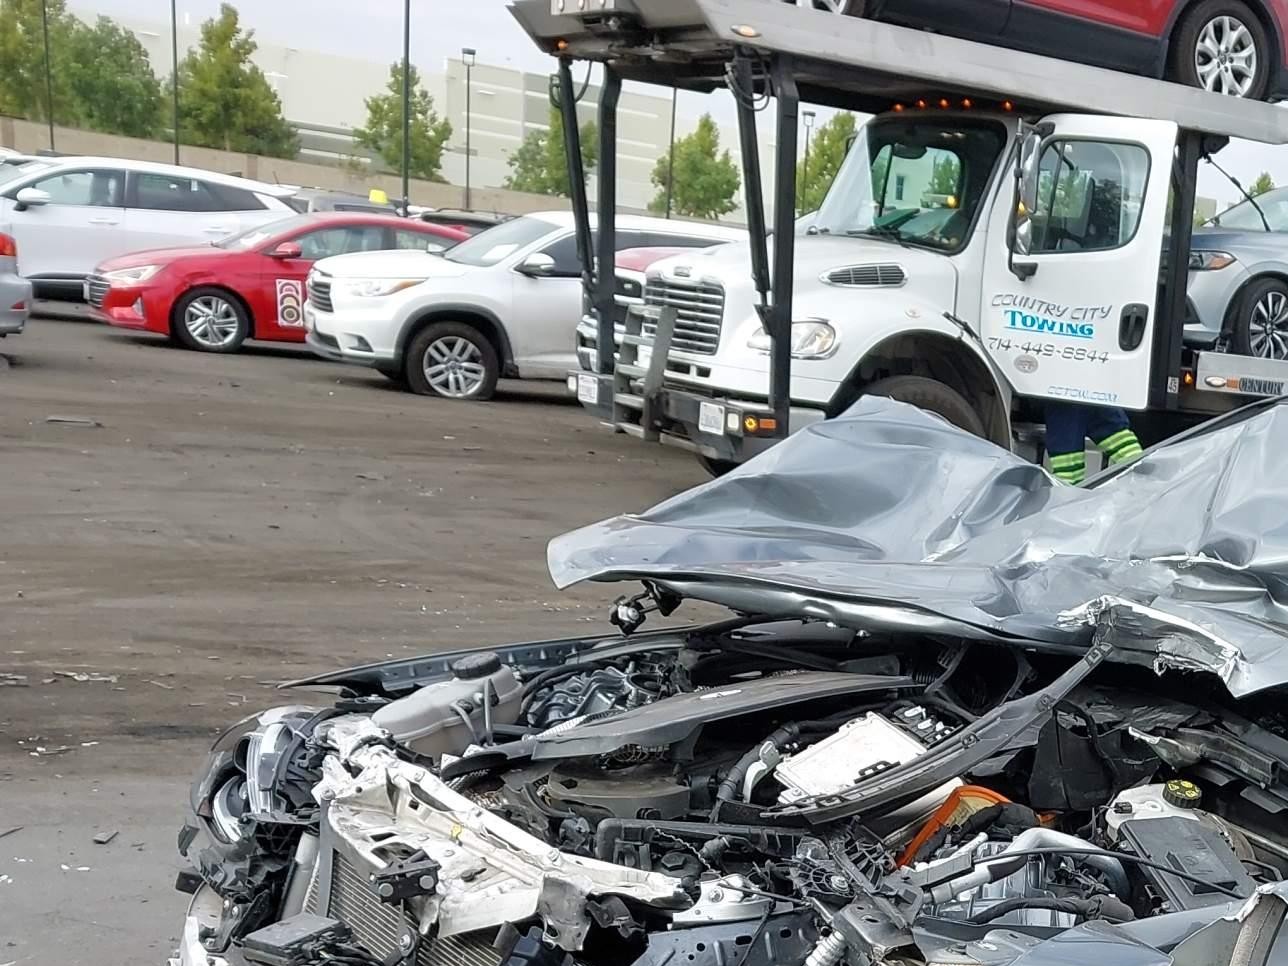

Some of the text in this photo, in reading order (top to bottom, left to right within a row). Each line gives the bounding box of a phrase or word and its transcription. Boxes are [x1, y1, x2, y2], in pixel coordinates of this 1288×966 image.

[992, 294, 1113, 321] COUNTRY CITY
[1004, 309, 1095, 336] TOWING
[1238, 377, 1285, 396] CENTURY
